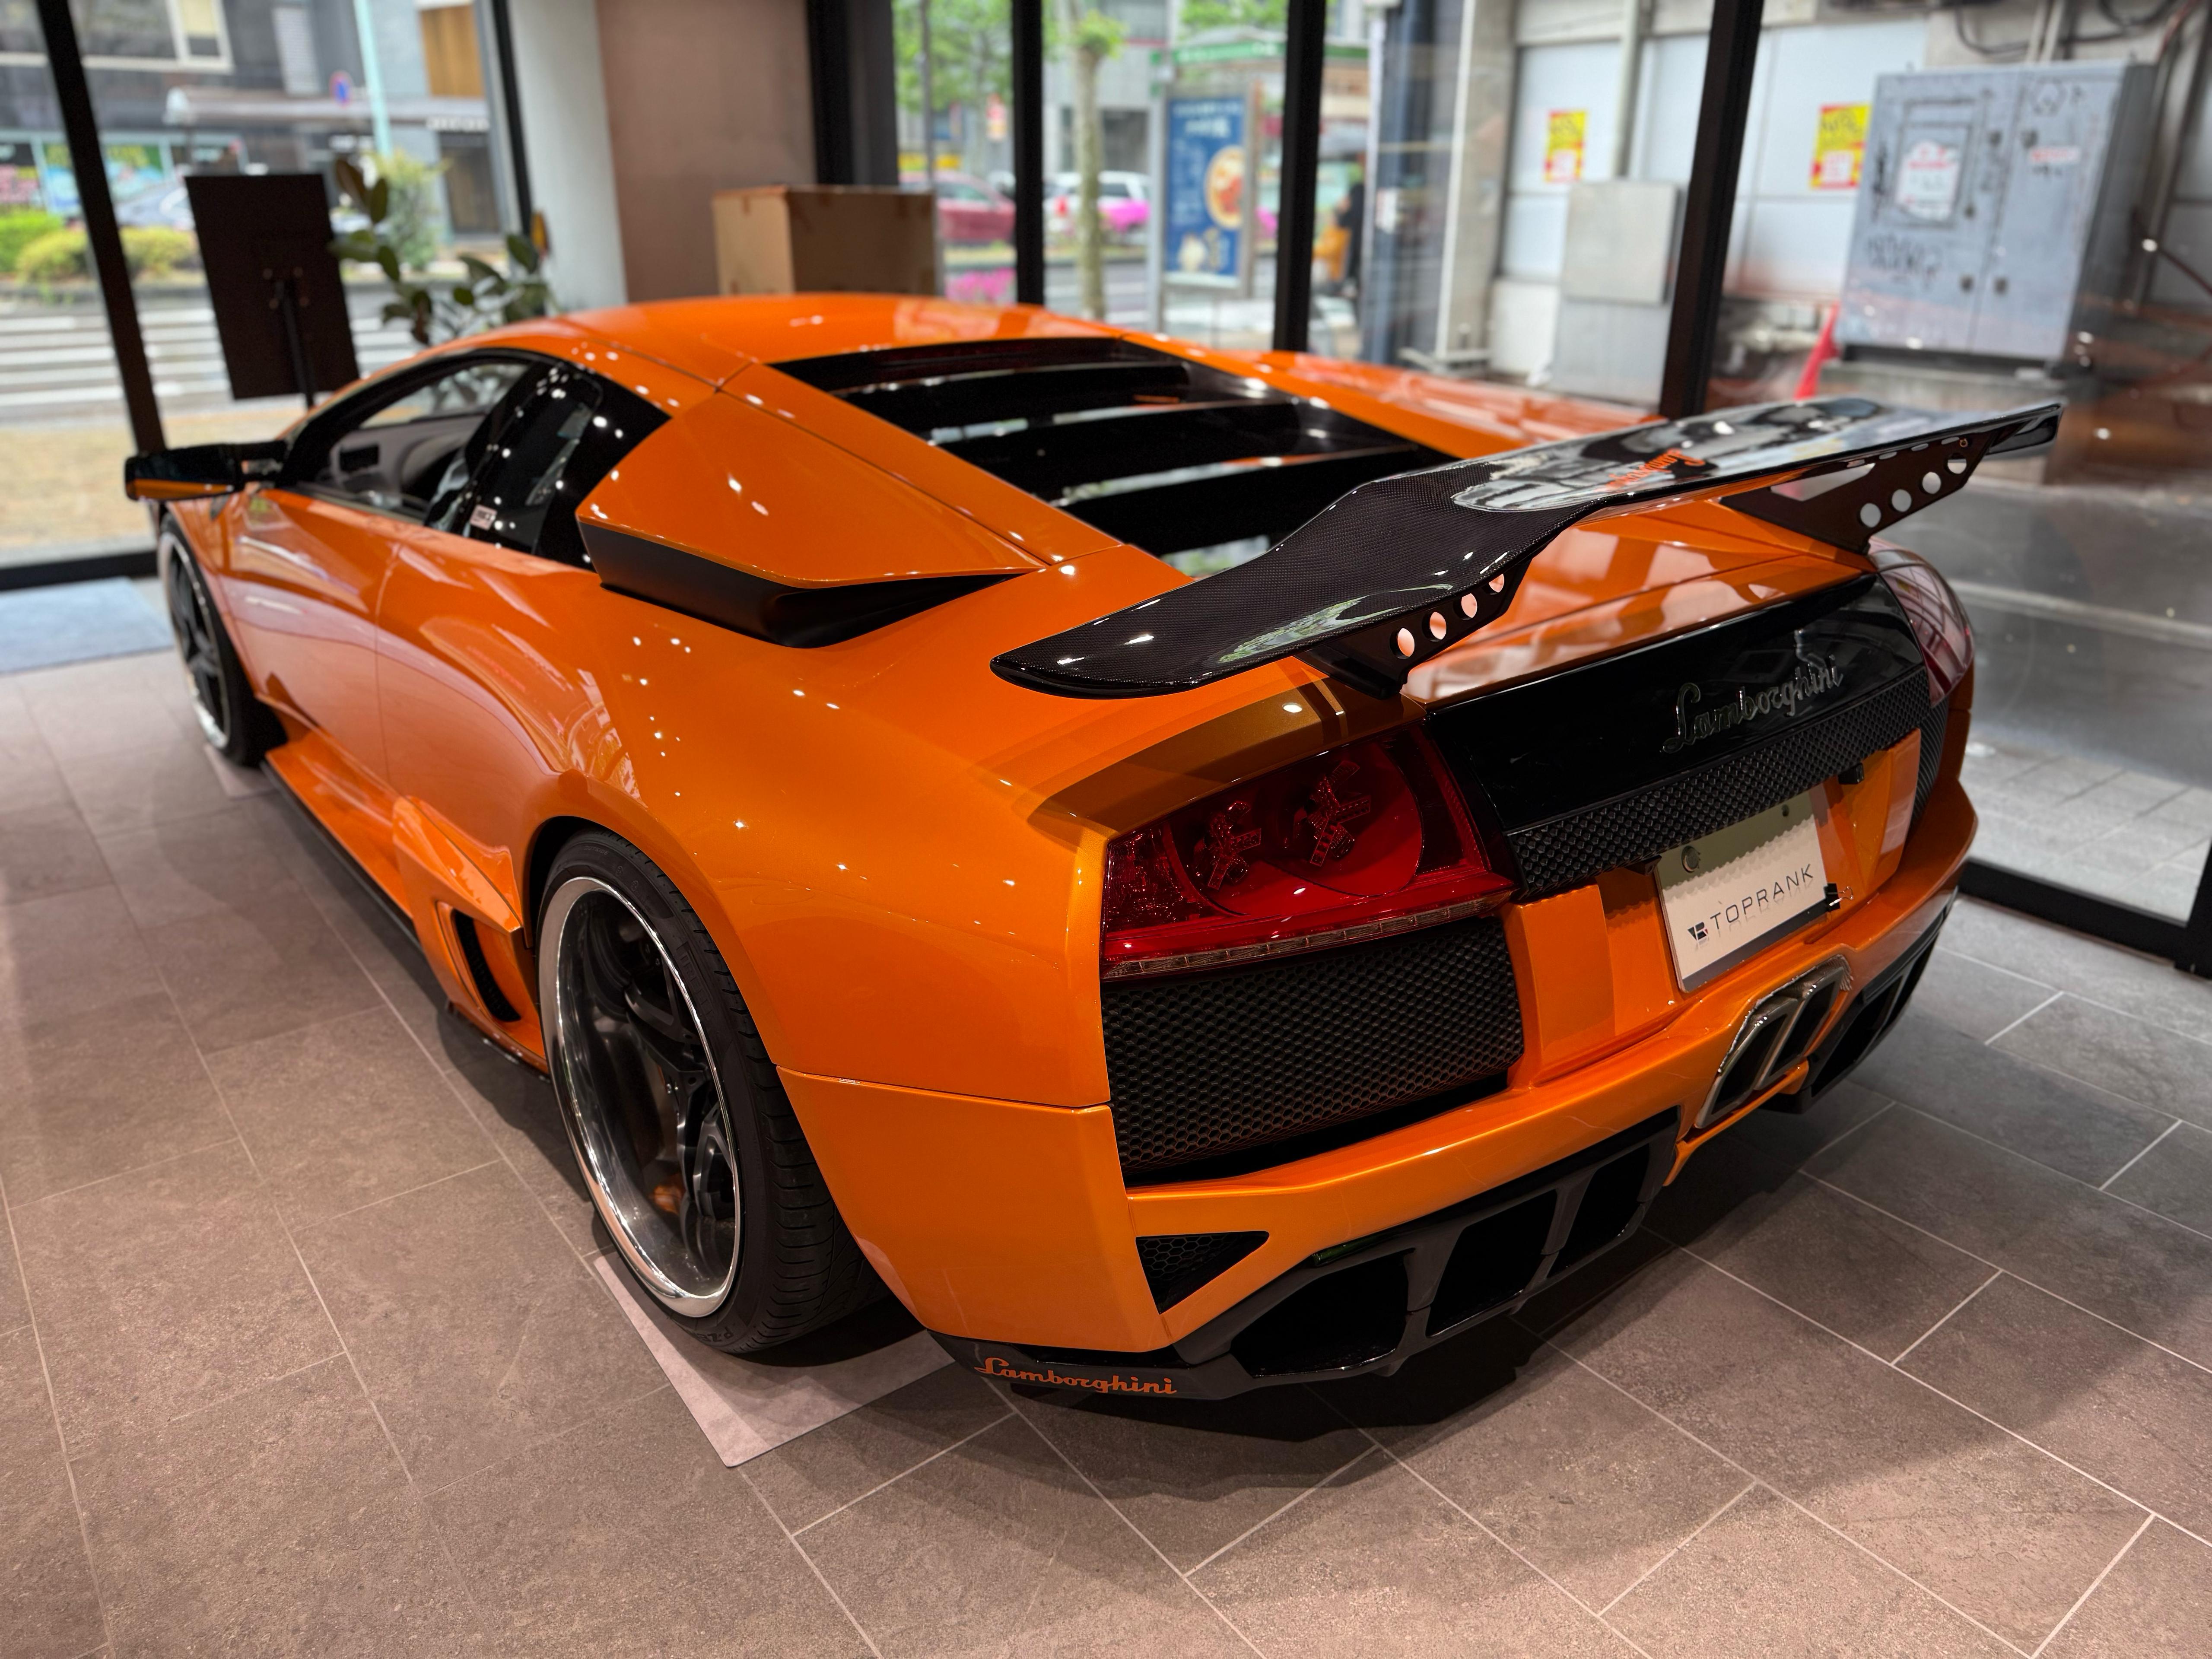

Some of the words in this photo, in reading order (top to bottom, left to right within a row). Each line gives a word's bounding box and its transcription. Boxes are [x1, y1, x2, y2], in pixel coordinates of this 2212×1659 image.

[1660, 654, 1843, 753] Lamborghini
[1710, 863, 1813, 930] TOPRANK
[974, 1357, 1177, 1394] Lamborghini
